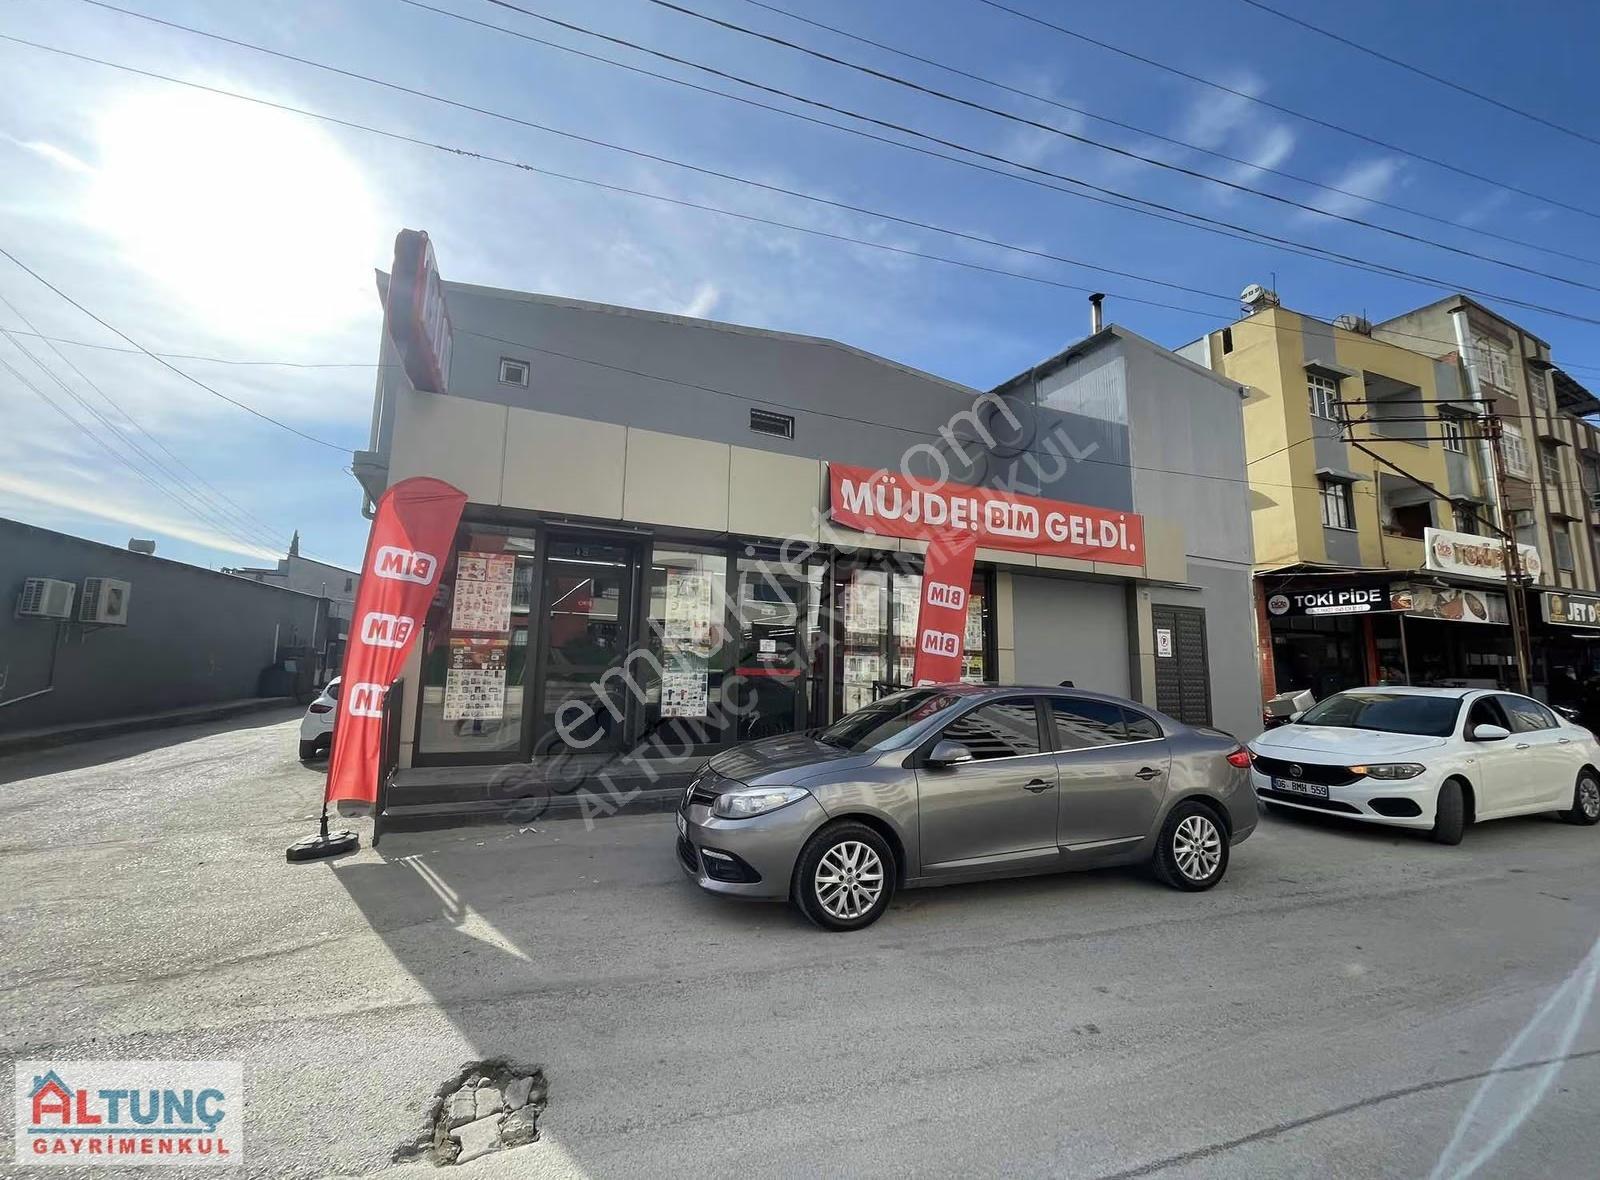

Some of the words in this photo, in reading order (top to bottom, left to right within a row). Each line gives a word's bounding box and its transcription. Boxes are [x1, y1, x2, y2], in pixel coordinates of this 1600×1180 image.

[840, 475, 978, 531] MÜJDE!
[1045, 511, 1136, 552] GELDİ.
[1294, 591, 1334, 608] TOKİ
[1338, 588, 1382, 605] PİDE
[1567, 602, 1587, 622] JET
[1276, 779, 1286, 789] 06
[1310, 785, 1327, 796] 559
